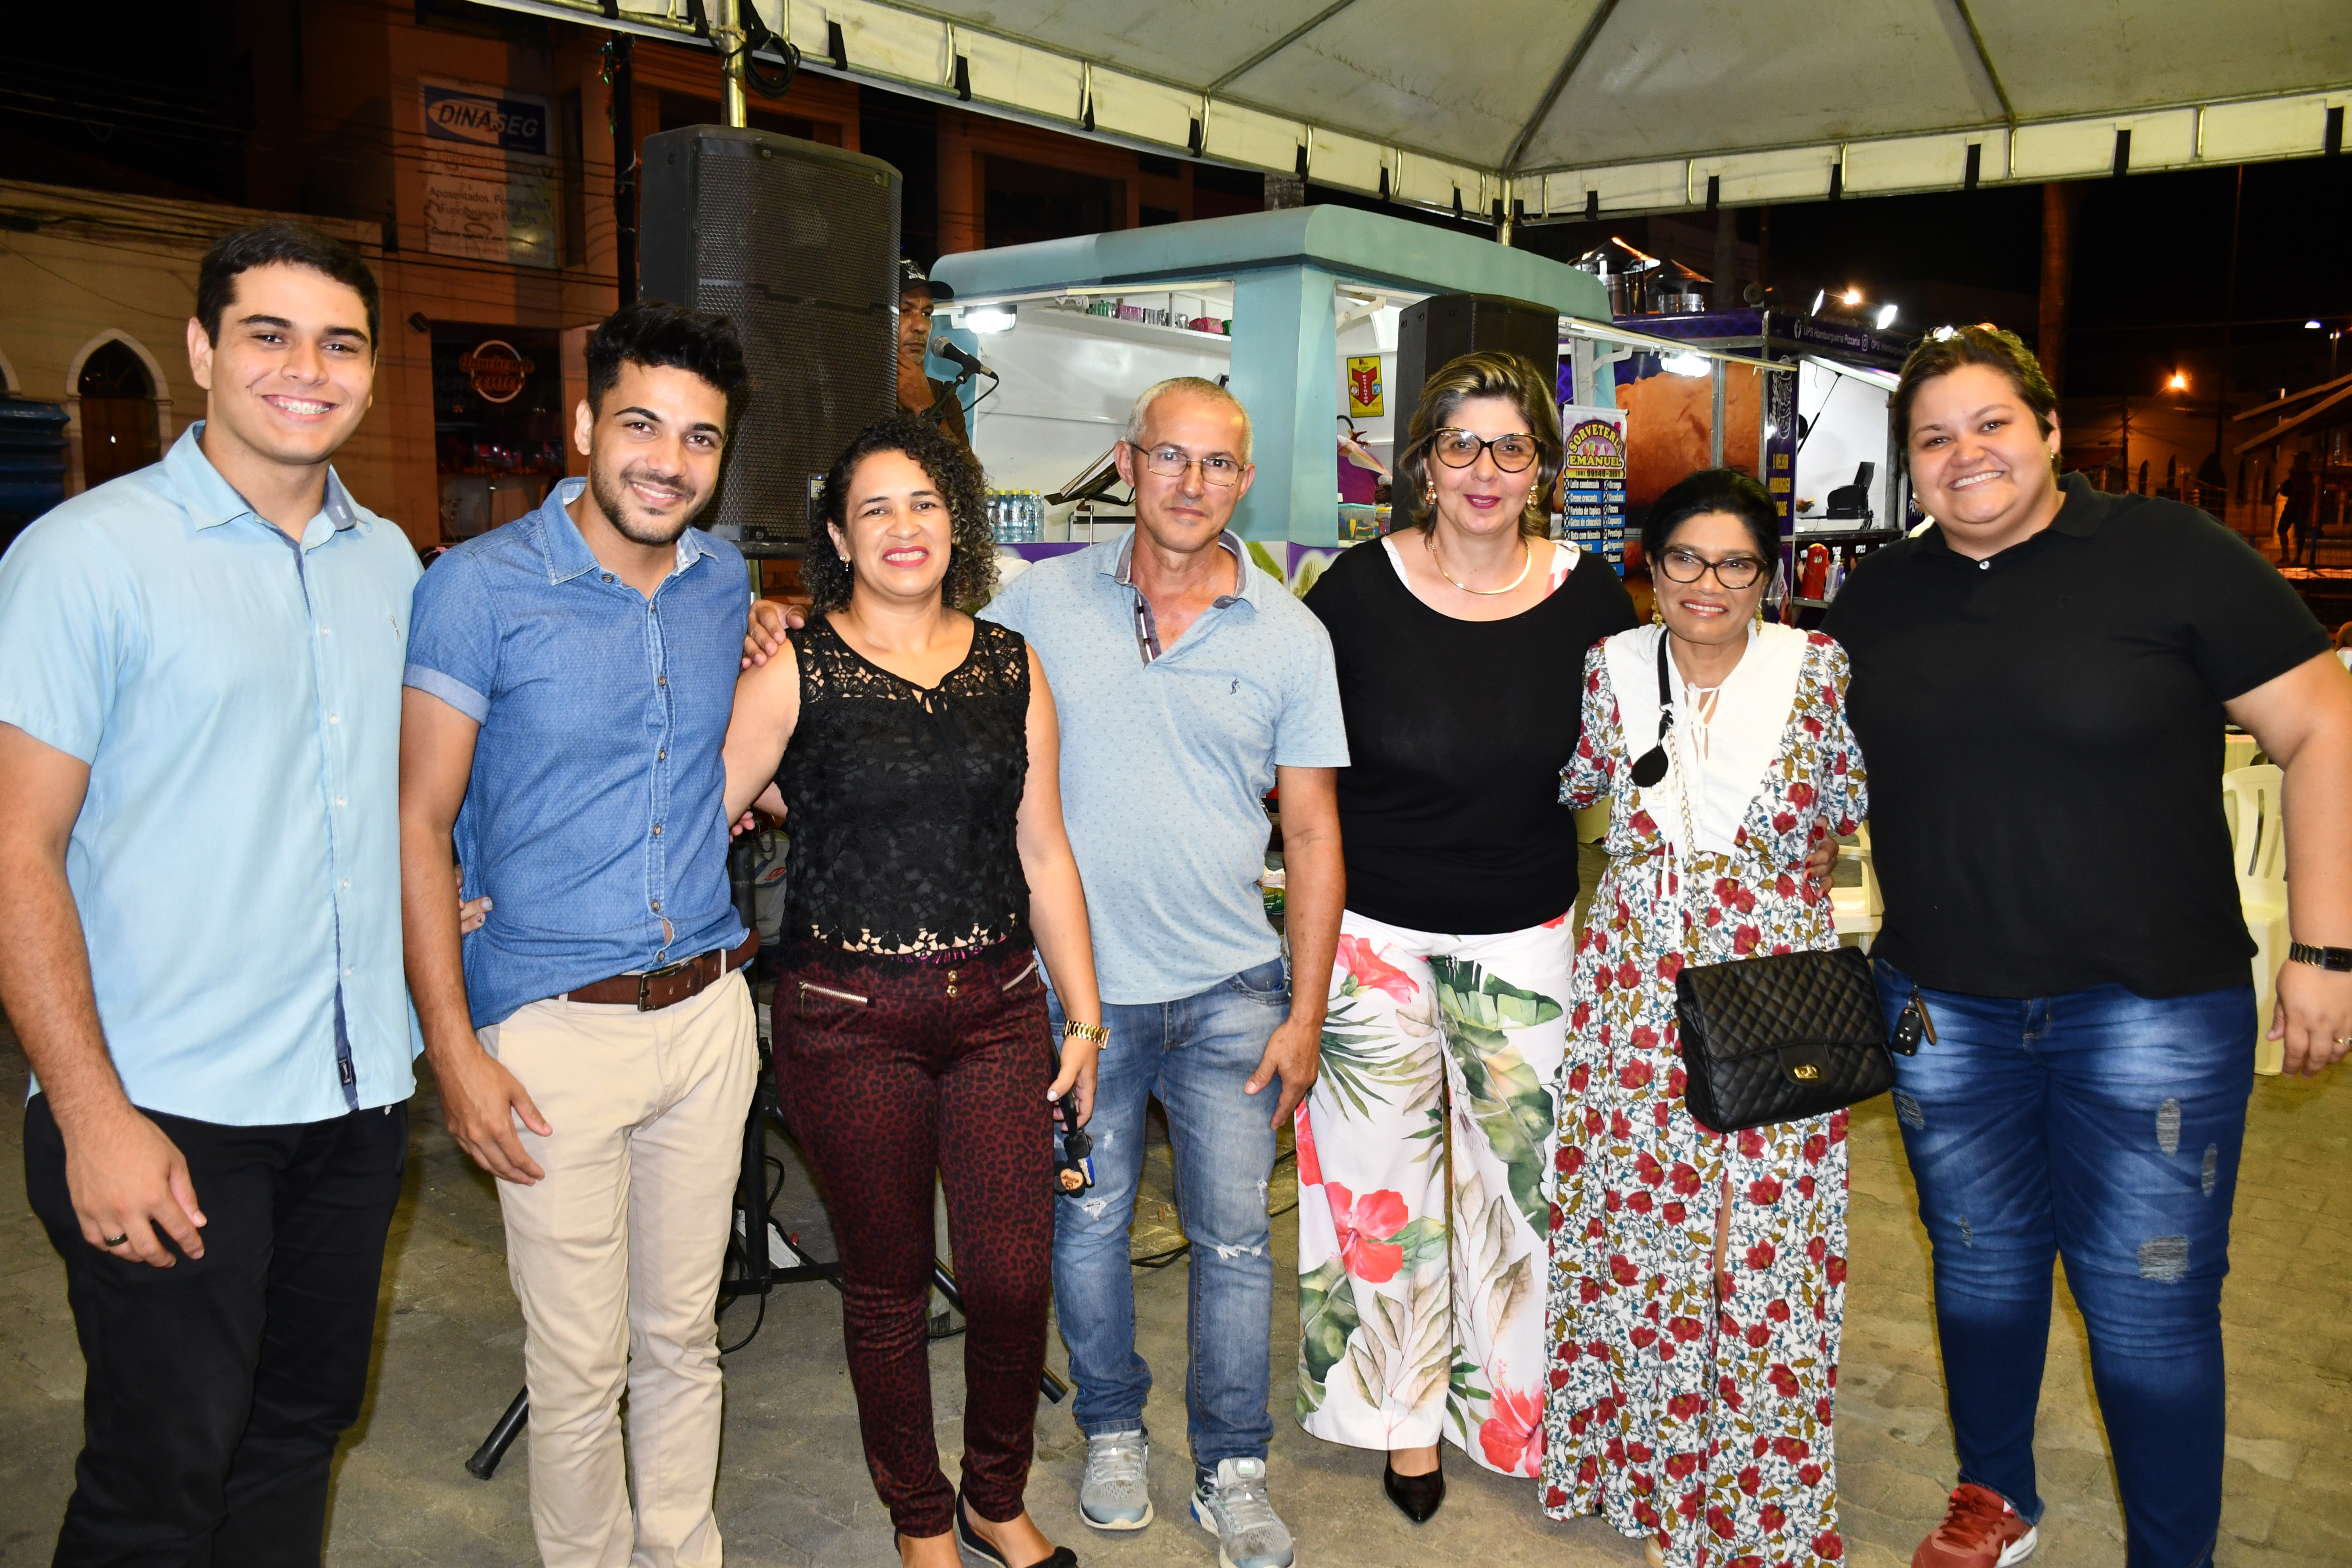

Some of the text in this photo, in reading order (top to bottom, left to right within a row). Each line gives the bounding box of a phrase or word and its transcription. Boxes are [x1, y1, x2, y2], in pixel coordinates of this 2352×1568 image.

[438, 105, 539, 138] DINASEG
[1569, 424, 1621, 454] SORVETERIA
[1569, 455, 1622, 466] EMANUEL
[1570, 493, 1582, 502] Creme
[1584, 506, 1589, 515] de
[1580, 517, 1585, 526] de
